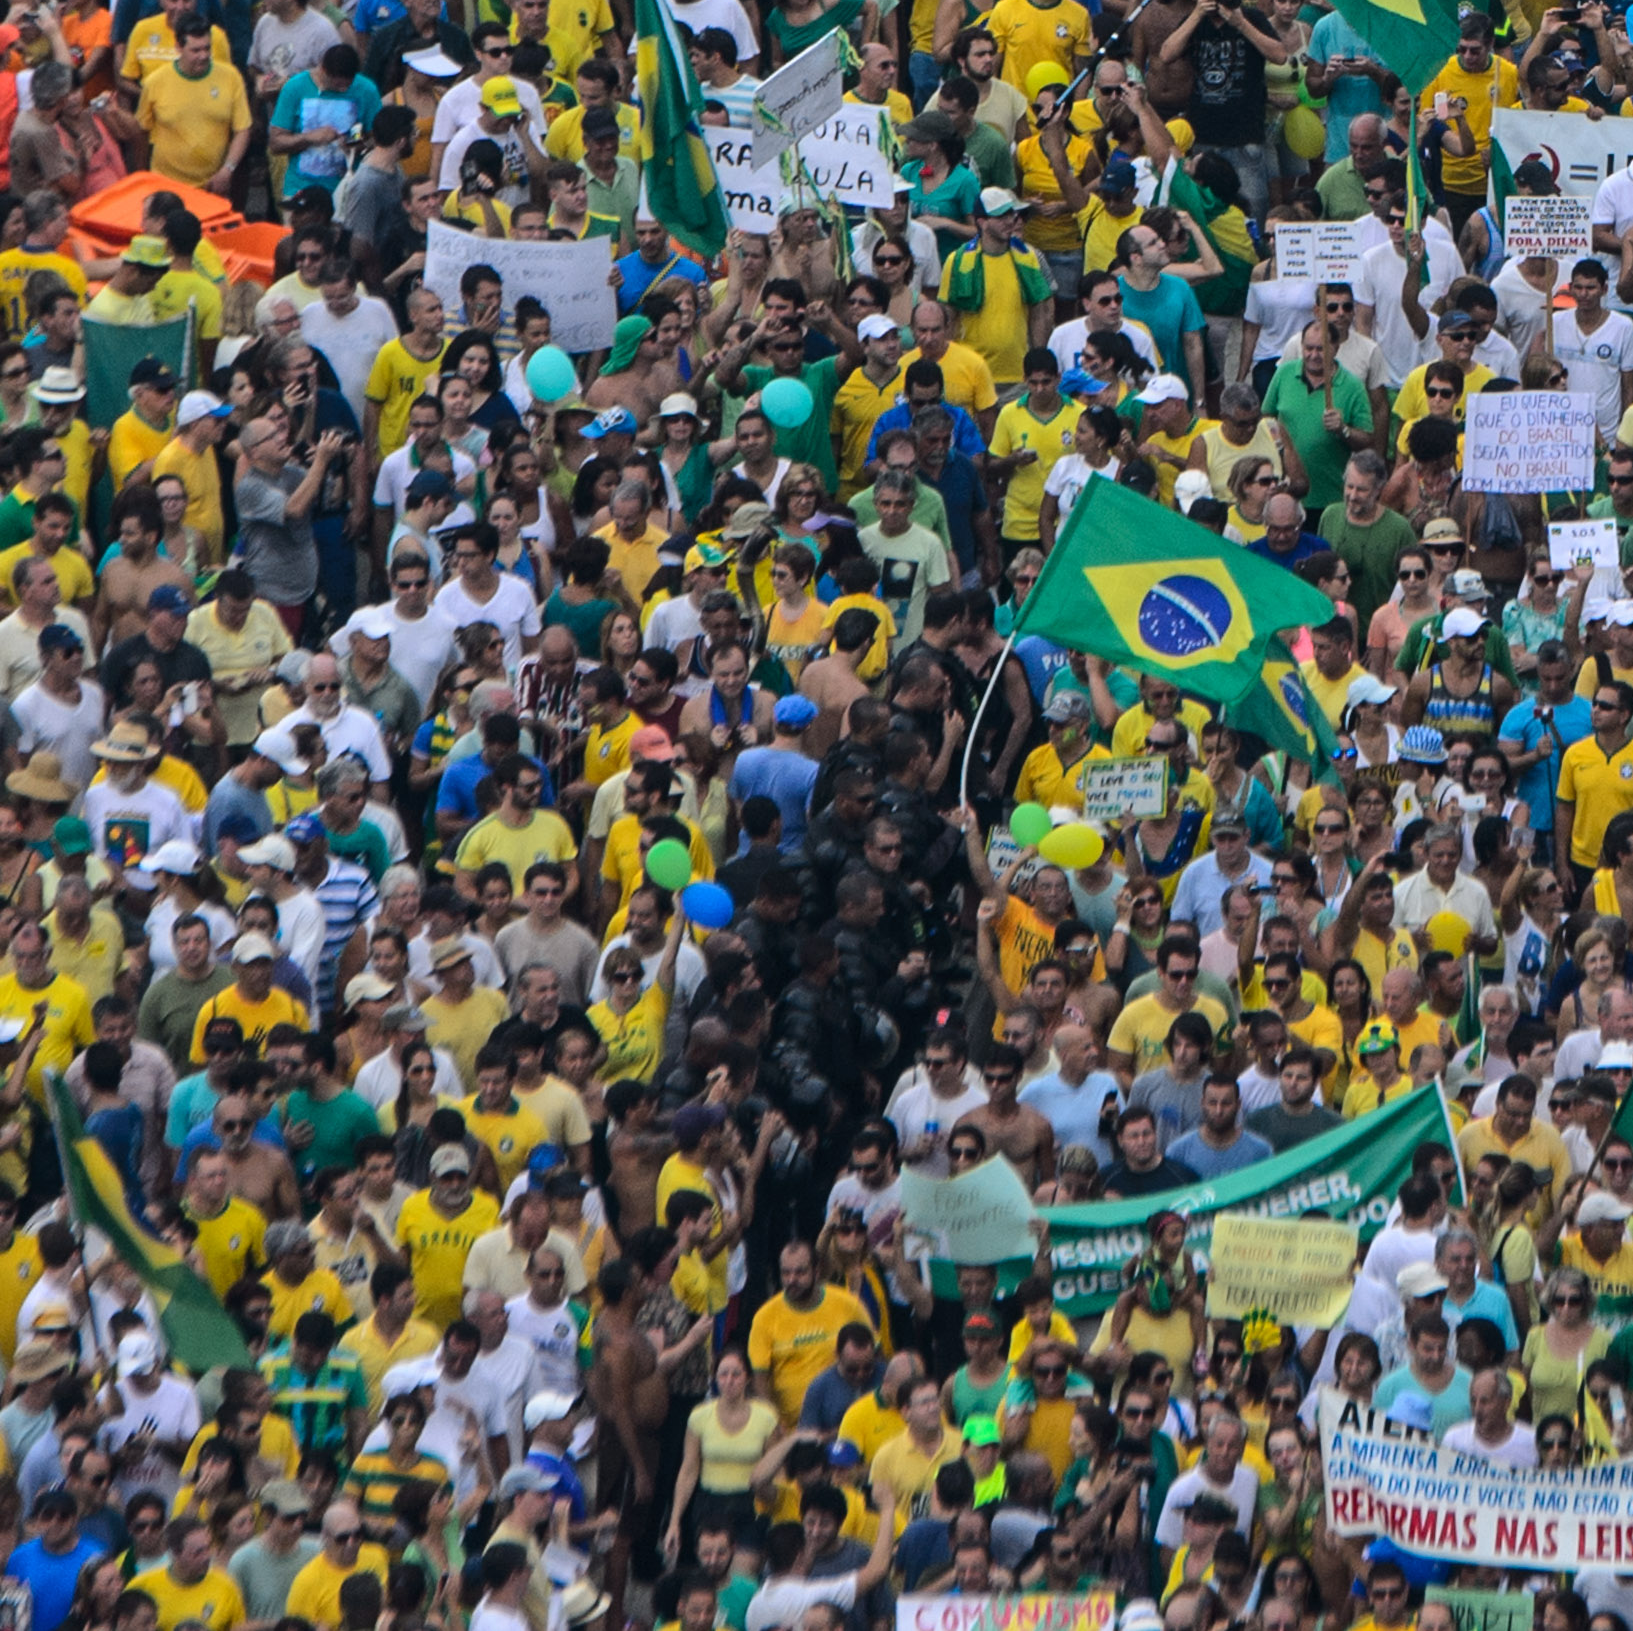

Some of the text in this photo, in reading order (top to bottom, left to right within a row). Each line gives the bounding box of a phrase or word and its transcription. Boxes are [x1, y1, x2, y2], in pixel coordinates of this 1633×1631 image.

[1507, 236, 1588, 247] FORA DILMA
[1500, 395, 1572, 412] EU QUERO
[1474, 412, 1595, 429] QUE O DINHEIRO
[1498, 429, 1579, 445] DO BRASIL
[1472, 444, 1595, 461] SEJA INVESTIDO
[1496, 462, 1572, 478] NO BRASIL
[1463, 476, 1591, 491] COM HONESTIDADE
[1331, 1433, 1344, 1454] A
[1346, 1438, 1438, 1474] IMPRENSA
[1387, 1474, 1459, 1503] DO POVO
[1495, 1514, 1559, 1559] NAS
[914, 1596, 1110, 1631] COMUNISMO
